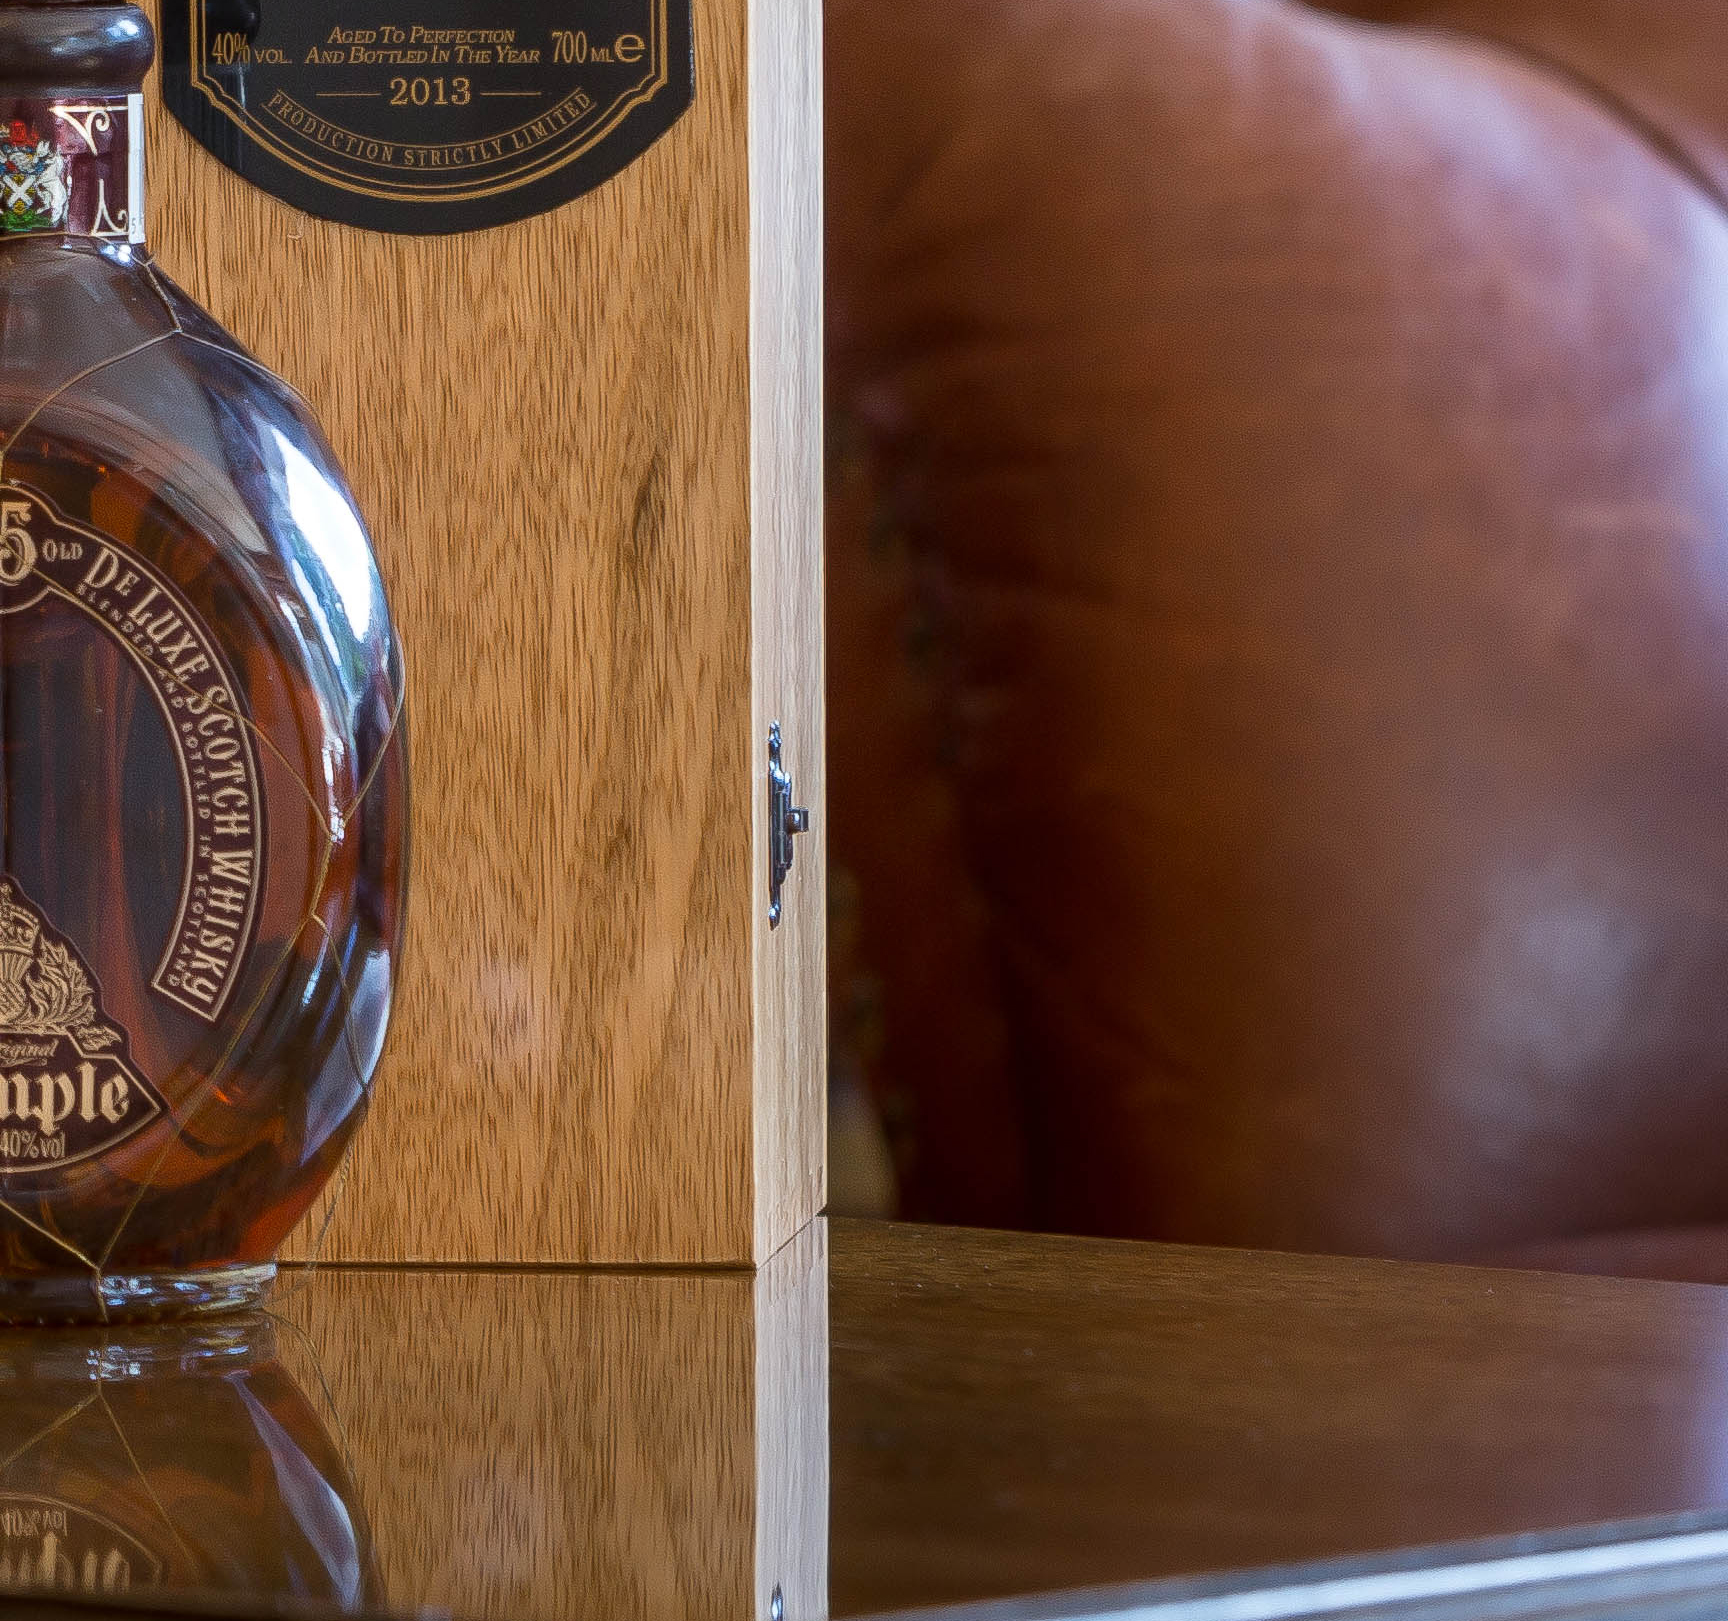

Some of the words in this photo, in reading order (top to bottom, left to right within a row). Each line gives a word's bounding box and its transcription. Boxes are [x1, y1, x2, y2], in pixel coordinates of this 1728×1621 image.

[327, 26, 376, 43] AGED
[379, 26, 405, 43] TO
[410, 26, 515, 44] PERFECTION
[304, 46, 344, 64] AND
[348, 46, 428, 64] BOTTLED
[431, 47, 449, 64] IN
[454, 46, 492, 63] THE
[497, 46, 540, 63] YEAR
[390, 77, 471, 105] 2013
[267, 93, 392, 162] PRODUCTION
[403, 144, 502, 166] STRICTLY
[511, 92, 591, 150] LIMITED
[44, 539, 83, 561] OLD
[186, 685, 250, 837] SCOTCH
[183, 850, 254, 1004] WHISKY
[0, 1131, 40, 1158] 40%
[43, 1133, 65, 1158] vol
